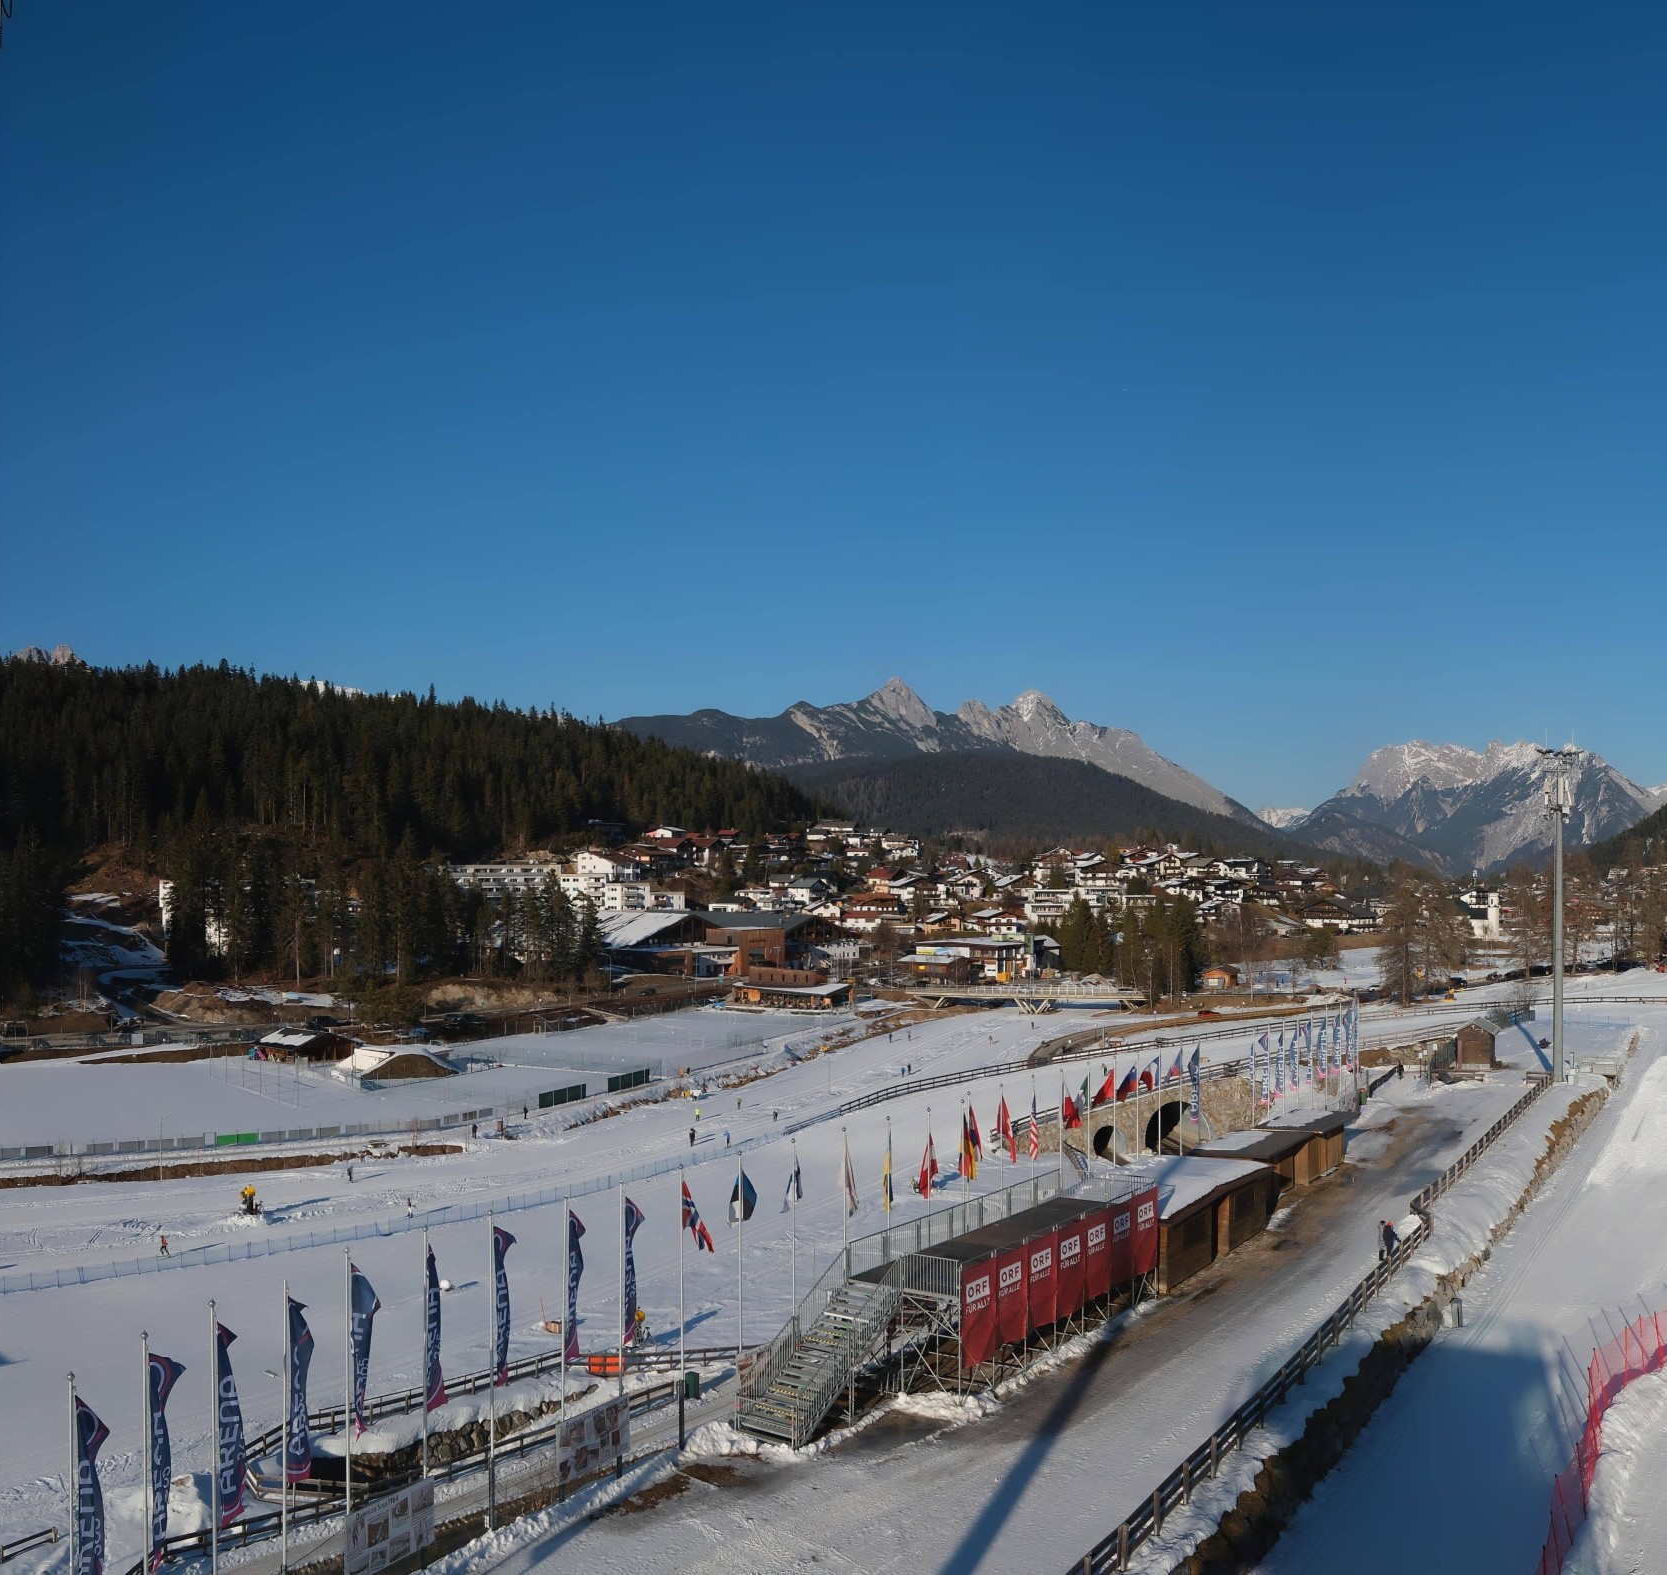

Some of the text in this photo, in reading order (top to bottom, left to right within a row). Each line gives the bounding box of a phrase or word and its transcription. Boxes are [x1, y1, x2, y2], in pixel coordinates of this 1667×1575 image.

[1138, 1205, 1154, 1220] ORF
[1114, 1215, 1130, 1231] ORF
[1089, 1226, 1105, 1243] ORF
[1061, 1238, 1079, 1256] ORF
[1032, 1251, 1051, 1269] ORF
[1001, 1265, 1020, 1284] ORF
[968, 1280, 988, 1299] ORF
[219, 1375, 241, 1495] ARENA
